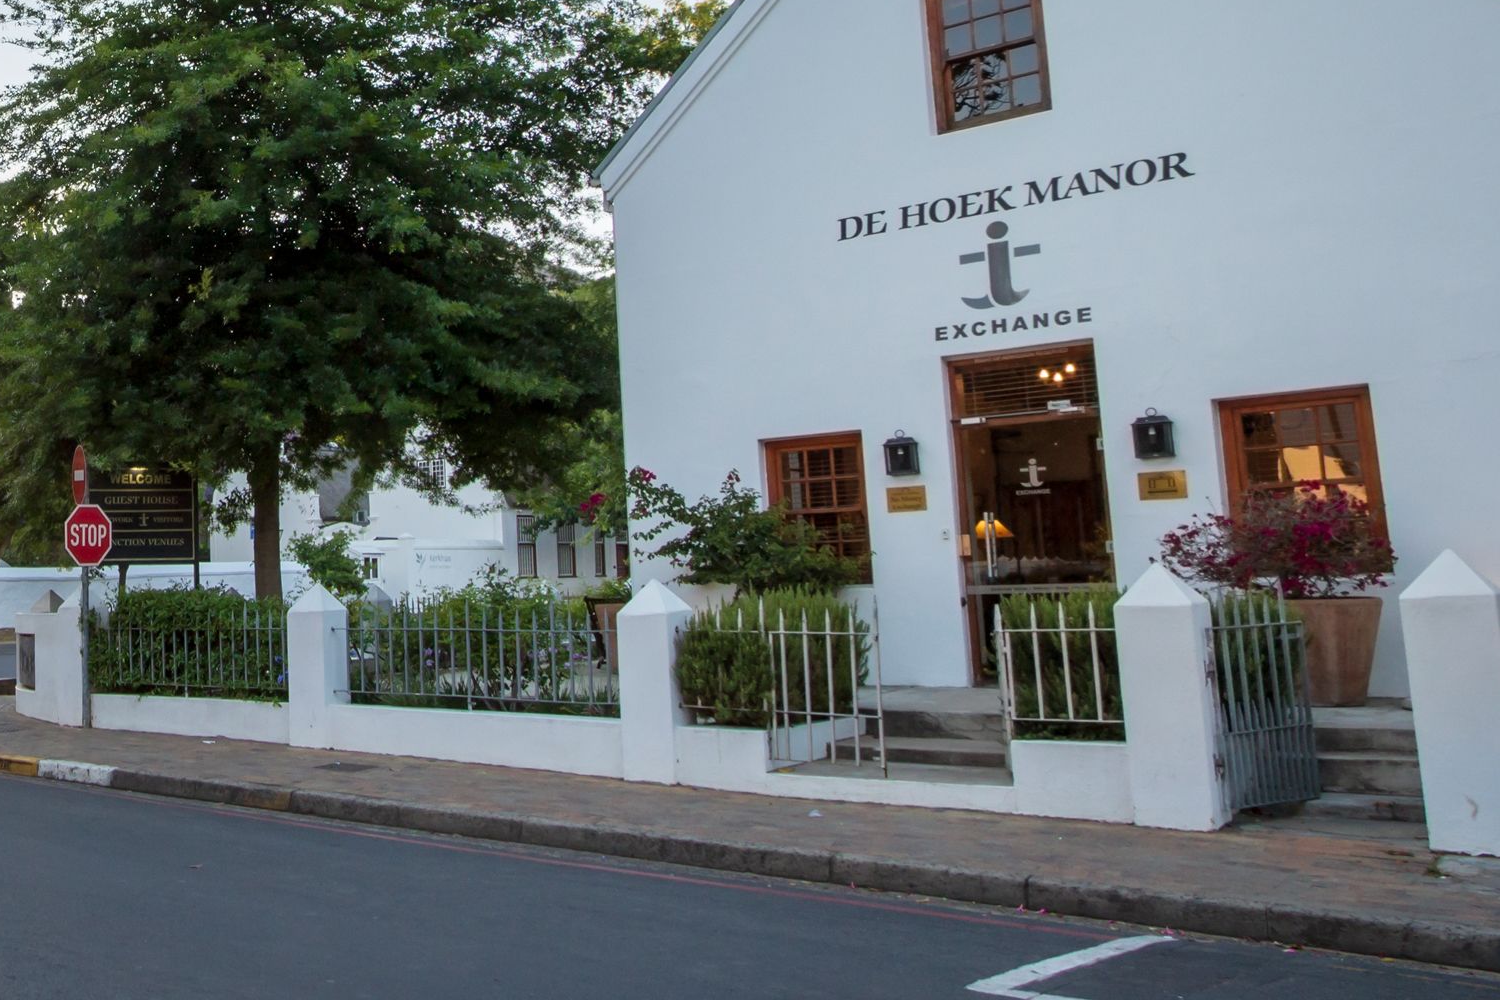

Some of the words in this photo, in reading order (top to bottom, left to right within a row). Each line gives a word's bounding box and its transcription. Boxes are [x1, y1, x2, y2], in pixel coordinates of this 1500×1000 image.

[836, 210, 888, 242] DE
[898, 185, 1017, 230] HOEK
[1023, 152, 1196, 207] MANOR
[935, 307, 1093, 342] EXCHANGE
[109, 473, 172, 485] WELCOME
[104, 496, 141, 505] GUEST
[142, 495, 179, 505] HOUSE
[70, 523, 108, 548] STOP
[111, 537, 146, 547] NCTION
[147, 537, 185, 547] VENUES
